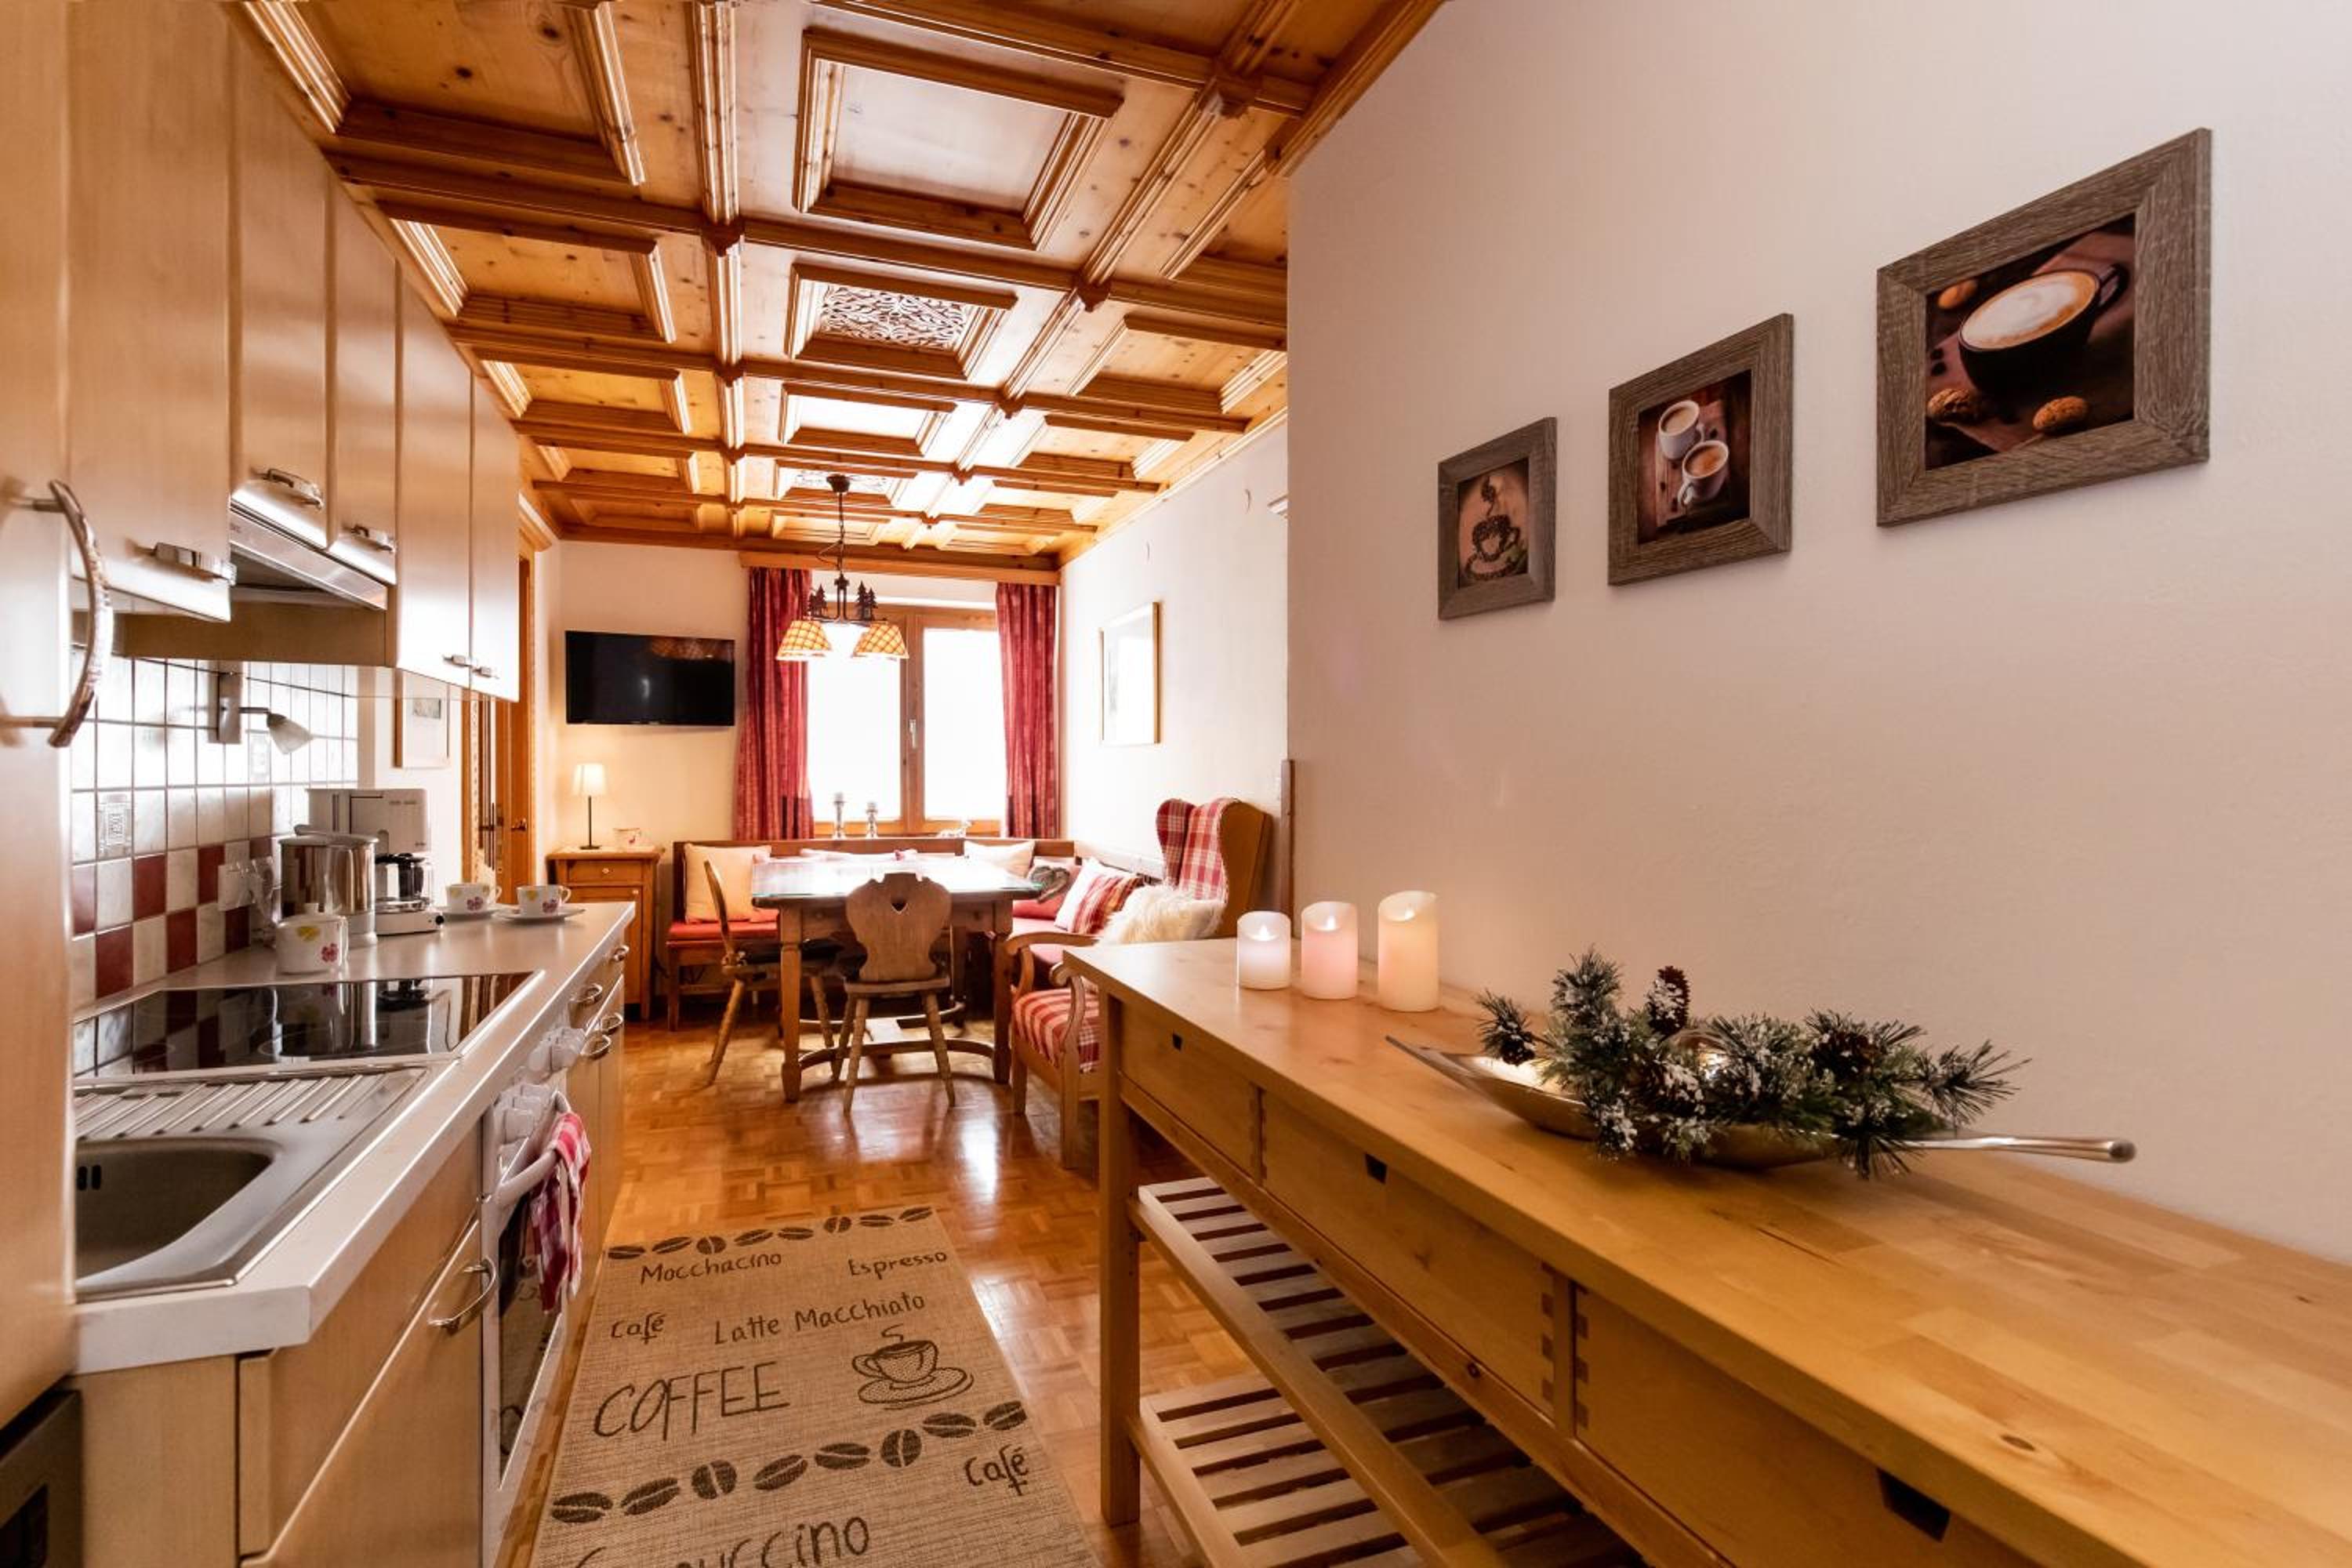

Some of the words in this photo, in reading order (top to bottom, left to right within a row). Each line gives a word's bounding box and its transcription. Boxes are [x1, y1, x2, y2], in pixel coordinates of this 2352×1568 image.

[640, 1253, 782, 1284] Mocchacino
[848, 1251, 948, 1280] Espresso
[714, 1314, 780, 1345] Latte
[794, 1291, 926, 1332] Macchiato
[593, 1360, 791, 1442] COFFEE
